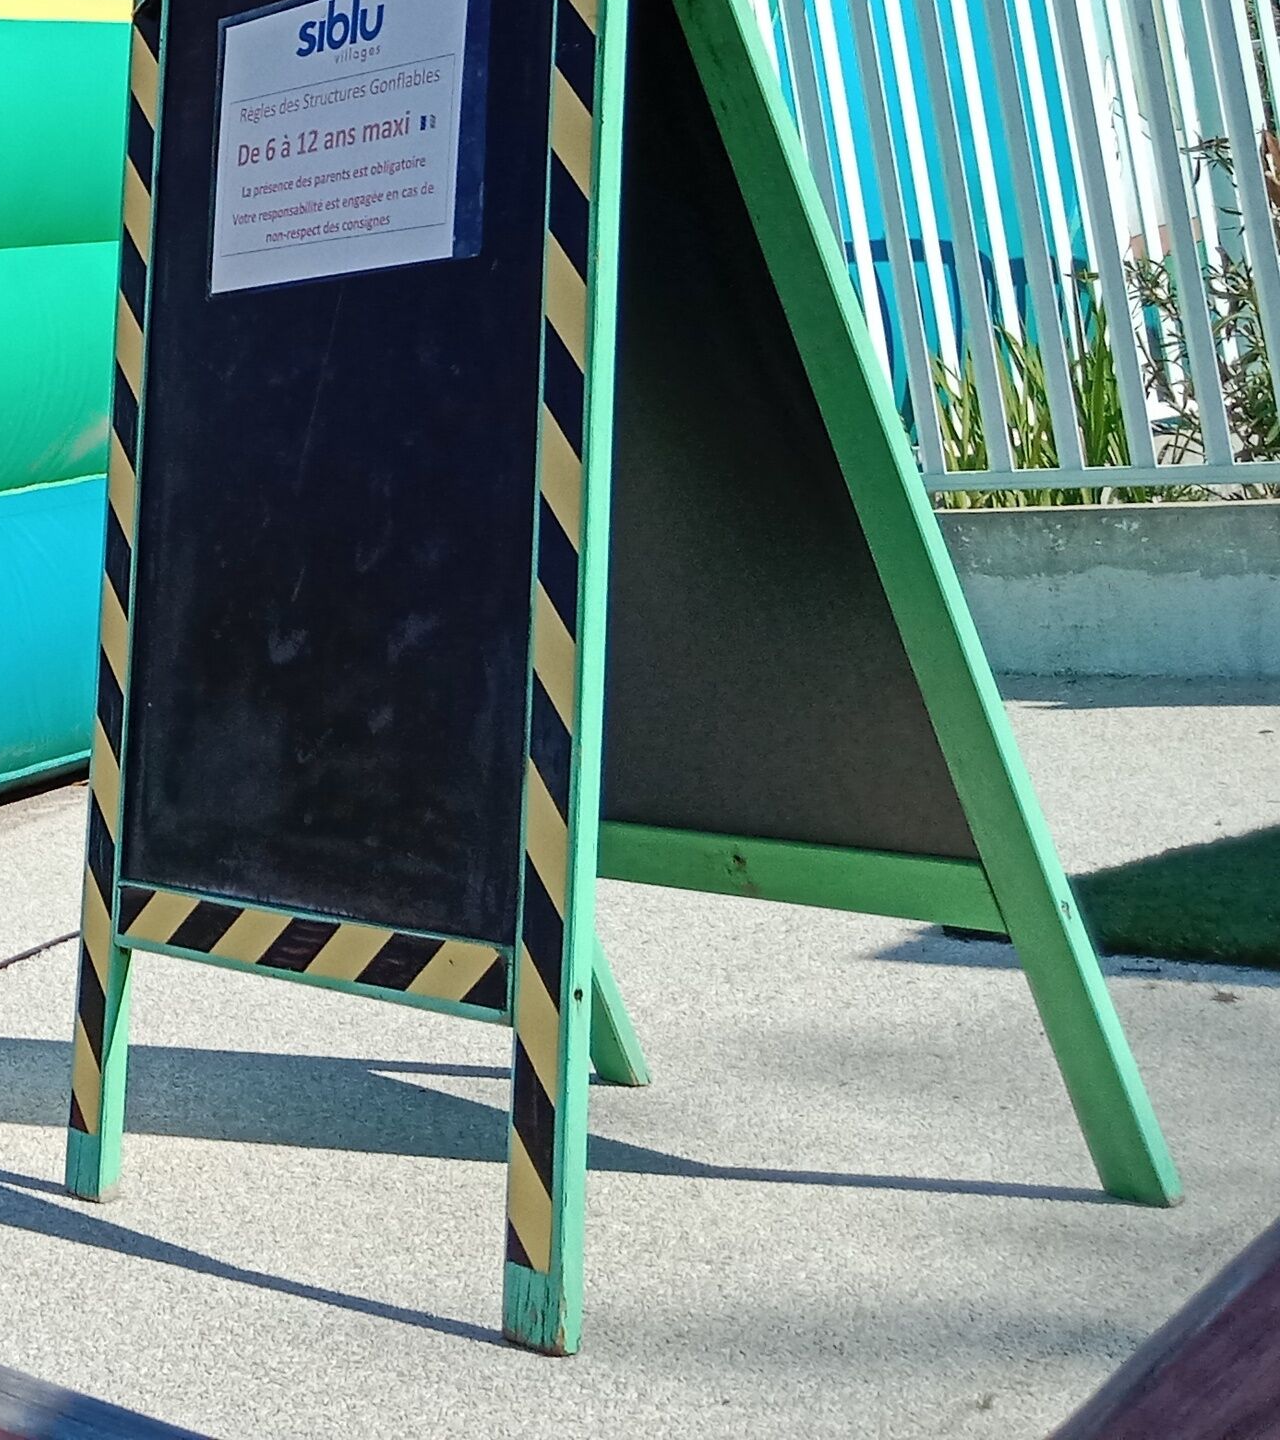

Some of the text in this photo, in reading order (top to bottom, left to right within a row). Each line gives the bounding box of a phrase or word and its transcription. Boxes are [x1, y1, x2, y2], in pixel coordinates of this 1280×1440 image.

[334, 45, 381, 64] villages
[279, 97, 300, 115] des
[302, 83, 366, 110] Structures
[369, 67, 441, 96] Gonflables
[237, 109, 411, 167] De 6 à 12 ans maxi
[241, 155, 427, 199] La présence des parents est obligatoire
[232, 180, 435, 226] Votre responsabilité est engagée en cas de
[265, 213, 391, 244] non-respect des consignes
